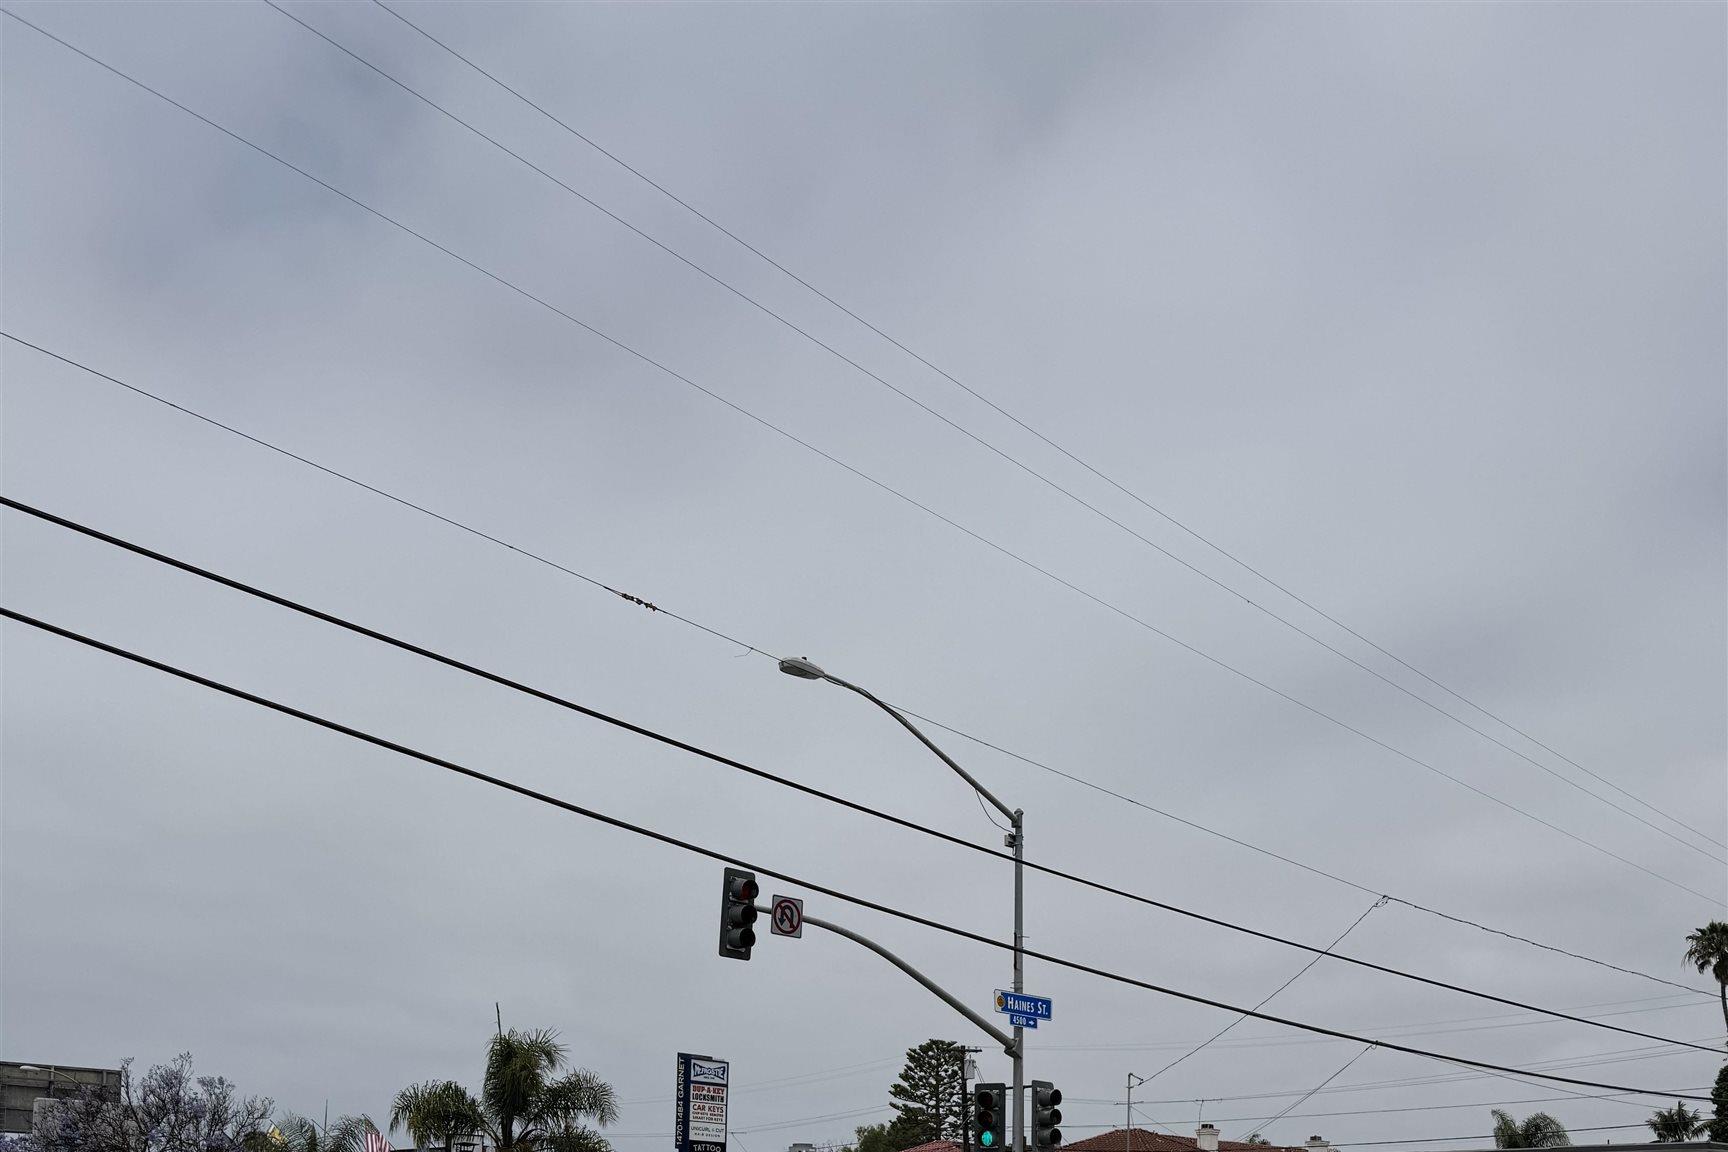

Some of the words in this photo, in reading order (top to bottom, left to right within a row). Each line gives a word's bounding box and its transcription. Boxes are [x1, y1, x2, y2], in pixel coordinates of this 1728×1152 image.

[1007, 996, 1035, 1013] HAINES
[1037, 1001, 1049, 1015] ST.
[677, 1057, 686, 1098] GARNET
[692, 1085, 725, 1095] DUP-A-KEY
[692, 1093, 725, 1103] LOCKSMITH
[692, 1104, 706, 1112] CAR
[707, 1105, 724, 1114] KEYS
[693, 1143, 722, 1152] TATTOO
